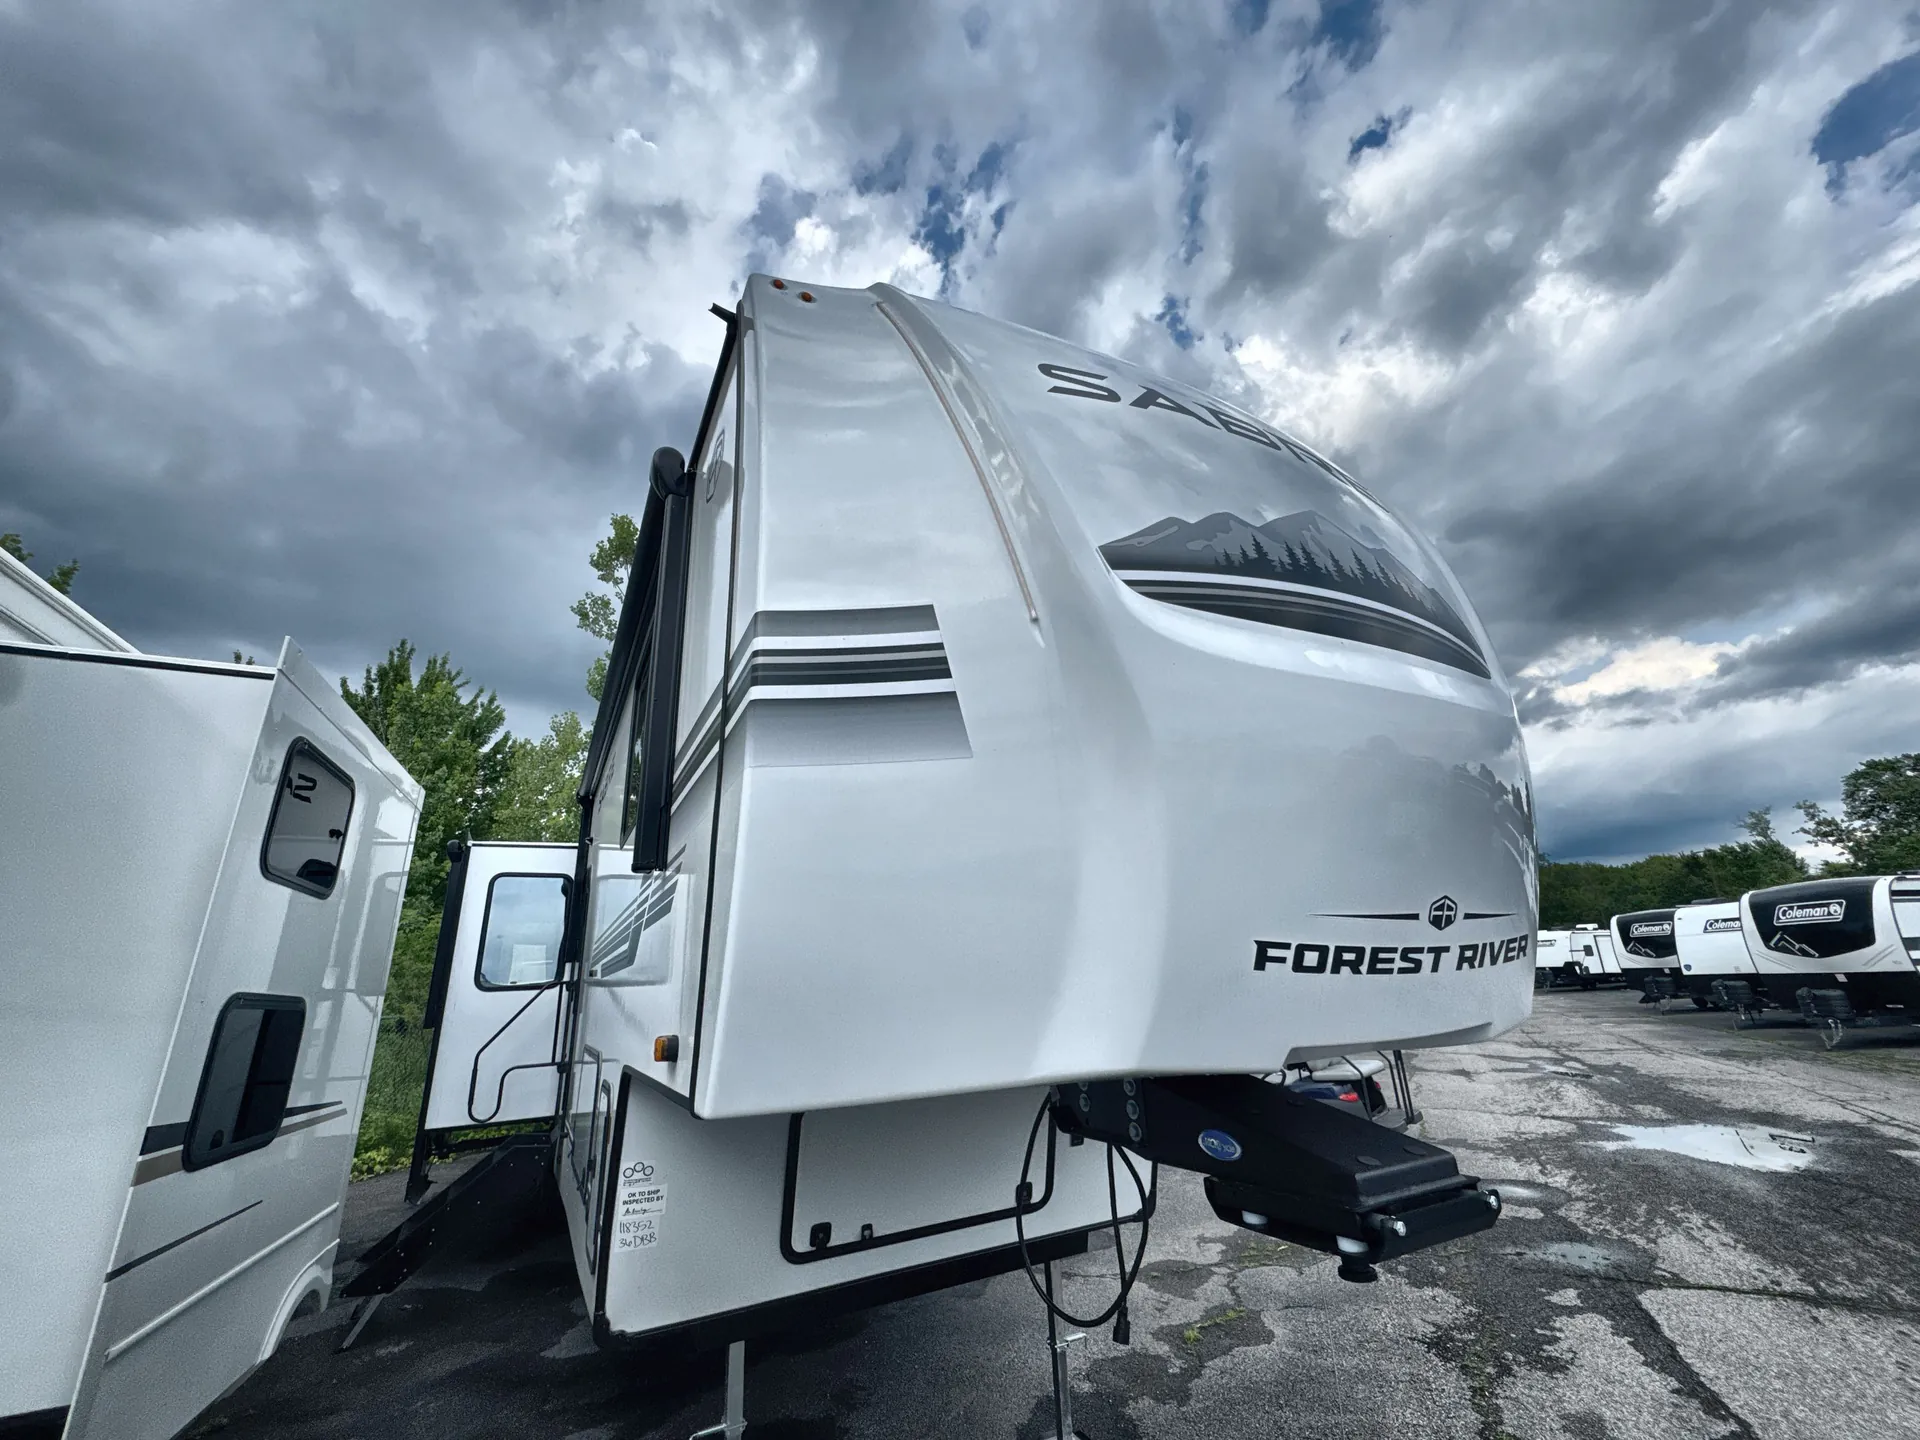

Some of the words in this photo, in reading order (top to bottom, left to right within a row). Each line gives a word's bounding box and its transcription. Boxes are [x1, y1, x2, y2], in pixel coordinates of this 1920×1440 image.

[1778, 905, 1828, 920] Coleman
[1633, 923, 1663, 935] Coleman
[1706, 919, 1741, 931] Colema
[1253, 939, 1451, 975] FOREST
[1455, 934, 1529, 971] RIVER
[622, 1196, 655, 1206] INSPECTED
